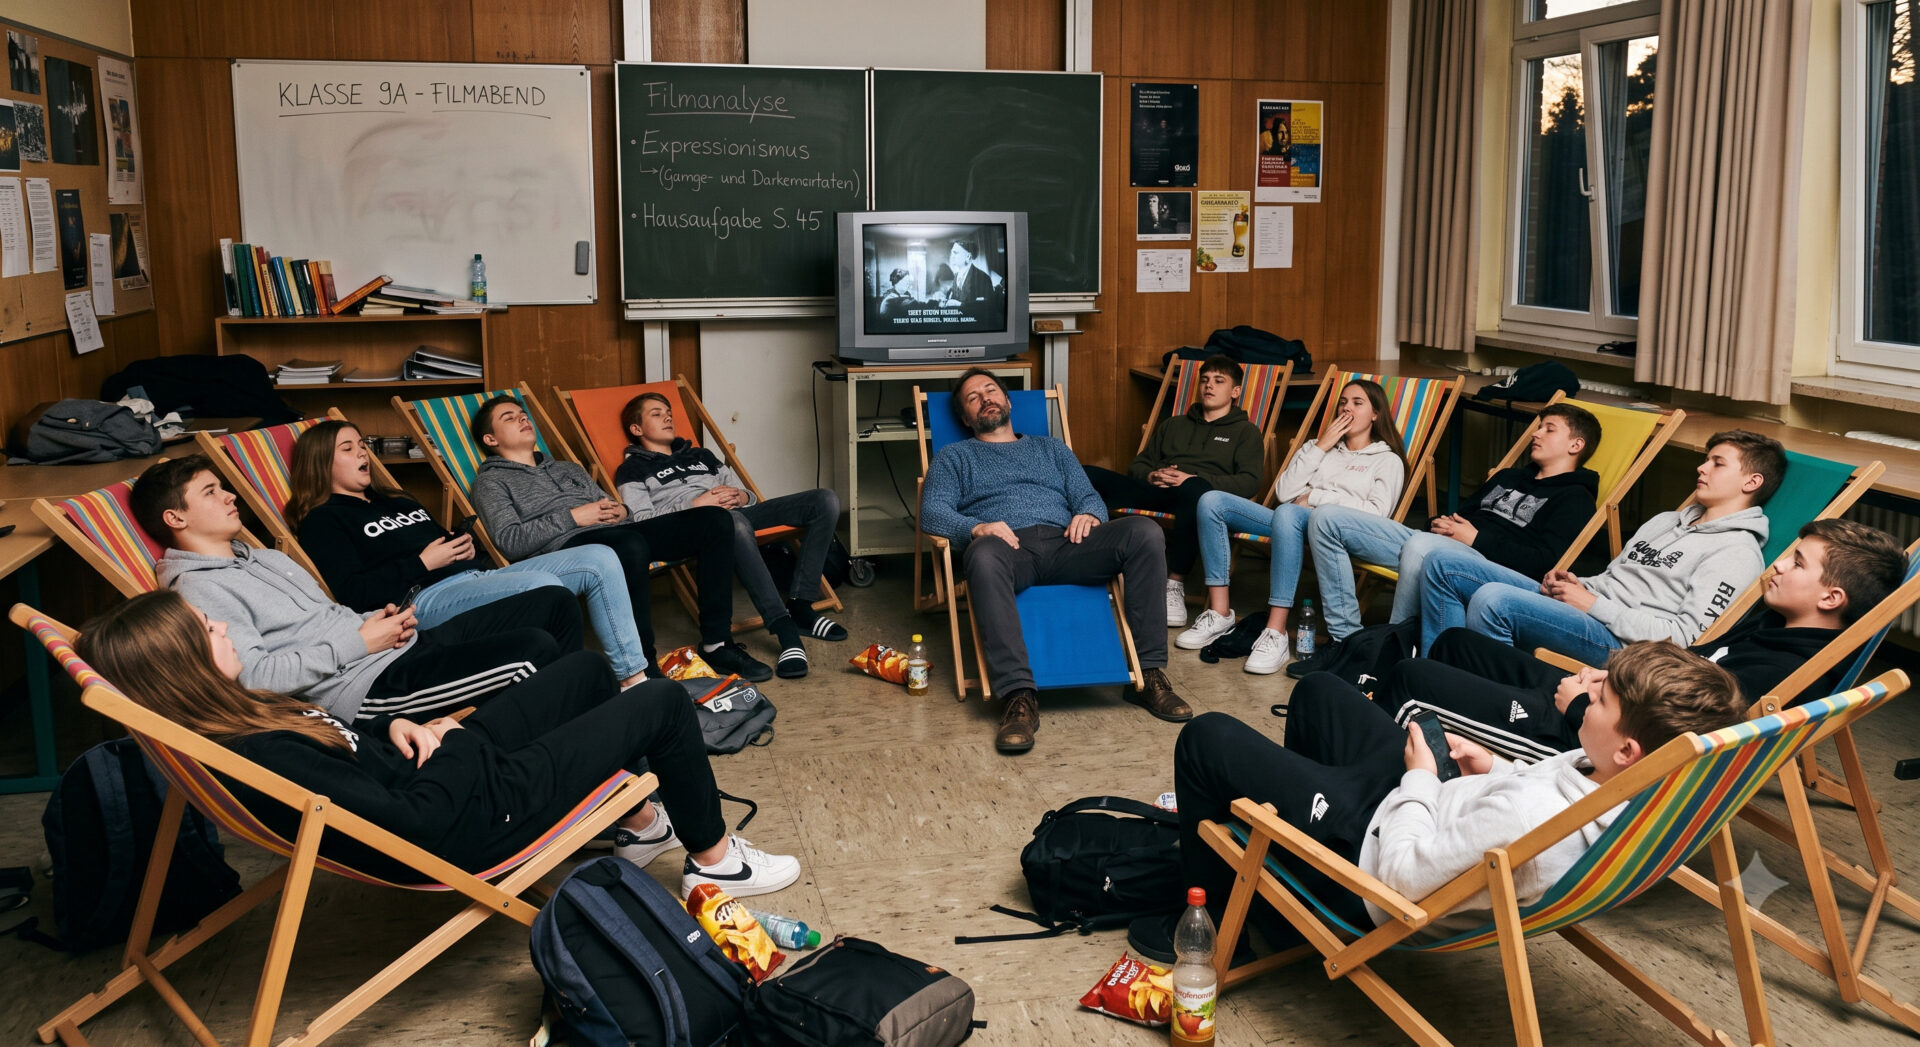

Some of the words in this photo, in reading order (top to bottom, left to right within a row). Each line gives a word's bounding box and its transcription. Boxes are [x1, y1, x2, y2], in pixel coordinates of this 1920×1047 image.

[278, 82, 364, 107] KLASSE
[379, 81, 408, 106] 9A
[430, 82, 546, 107] FILMABEND
[642, 81, 790, 124] Filmanalyse
[641, 129, 811, 164] Expressionismus
[721, 169, 746, 186] und
[643, 202, 763, 240] Hausaufgabe
[772, 207, 791, 230] S.
[796, 207, 824, 232] 45
